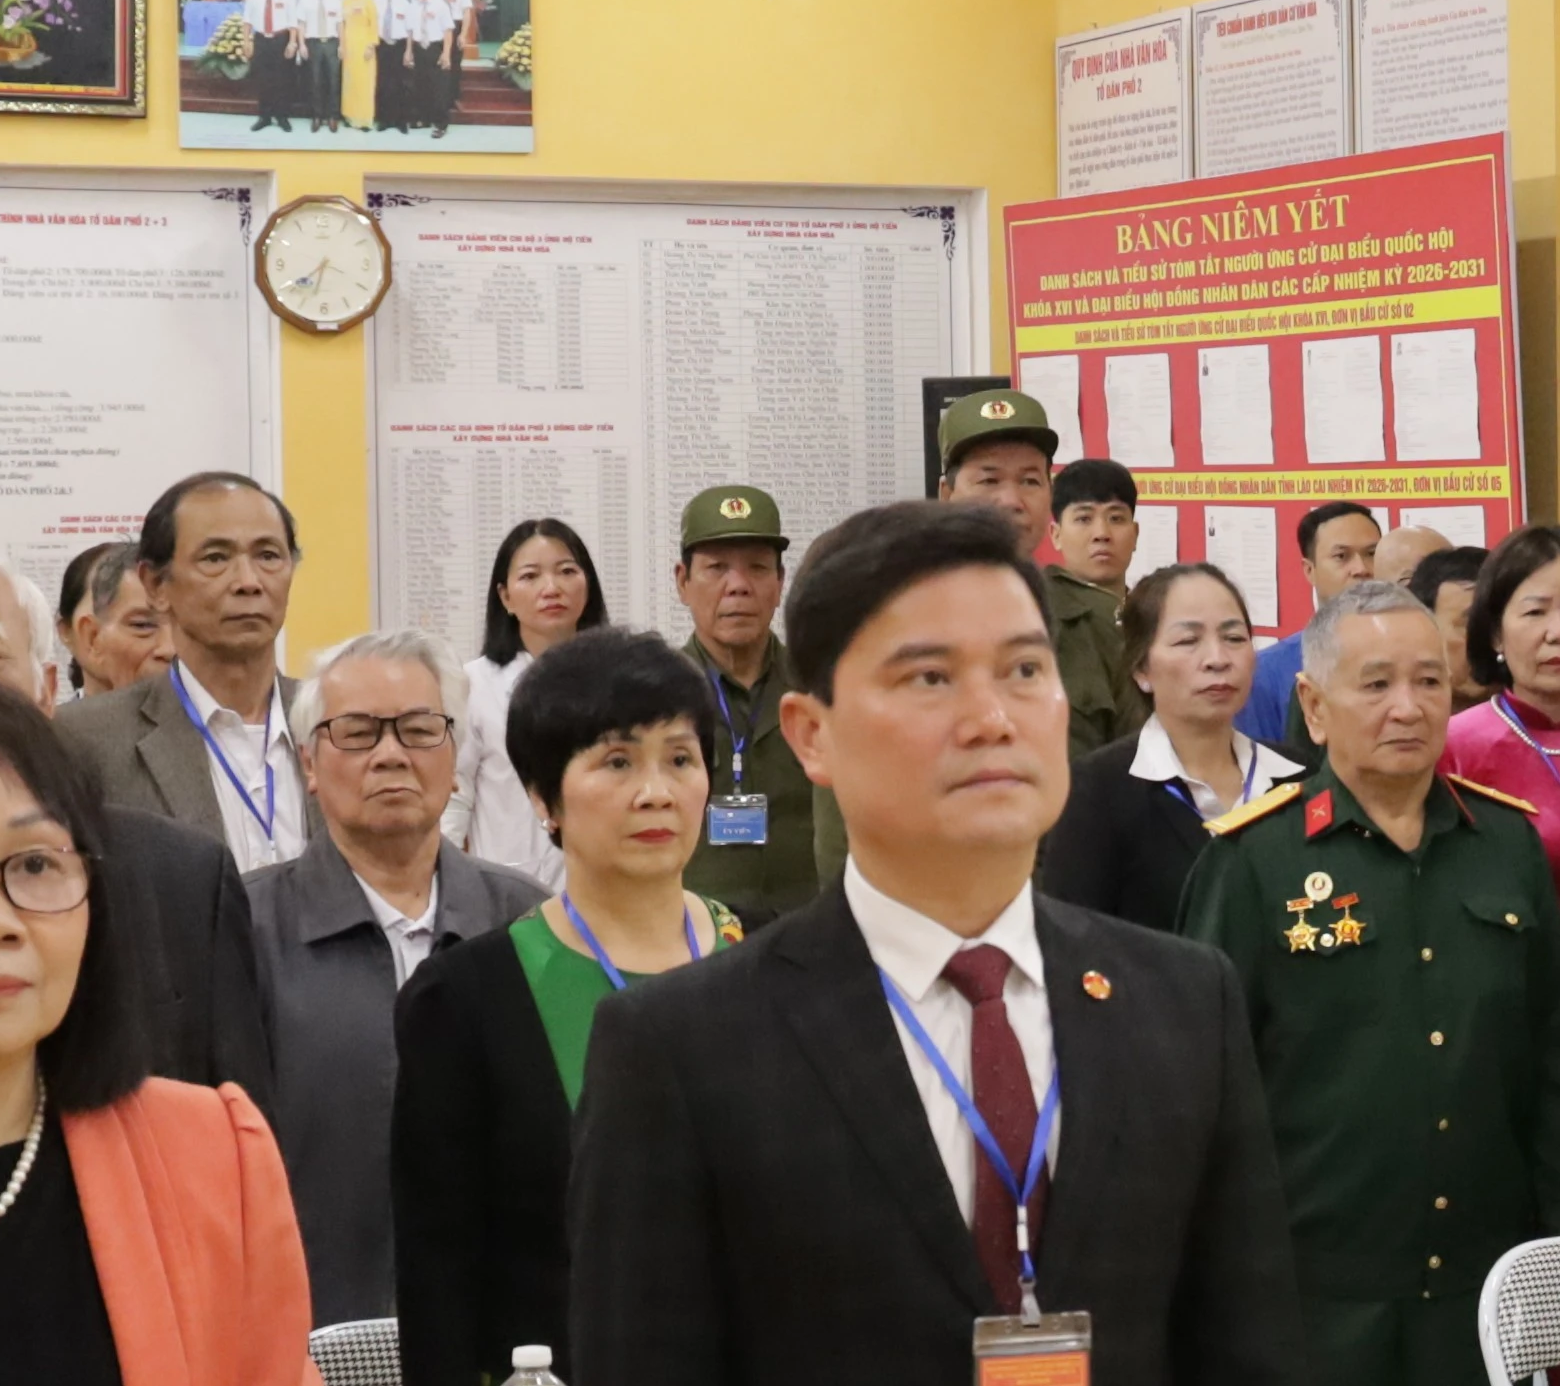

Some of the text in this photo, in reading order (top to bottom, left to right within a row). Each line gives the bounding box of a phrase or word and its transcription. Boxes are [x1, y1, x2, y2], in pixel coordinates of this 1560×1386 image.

[1116, 189, 1350, 254] BẢNG NIÊM YẾT
[1023, 257, 1486, 319] KHÓA XVI VÀ ĐẠI BIỂU HỘI ĐỒNG NHÂN DÂN CÁC CẤP NHIỆM KỲ 2026-2031
[1040, 226, 1454, 291] DANH SÁCH VÀ TIỂU SỬ TÓM TẮT NGƯỜI ỨNG CỬ ĐẠI BIỂU QUỐC HỘI
